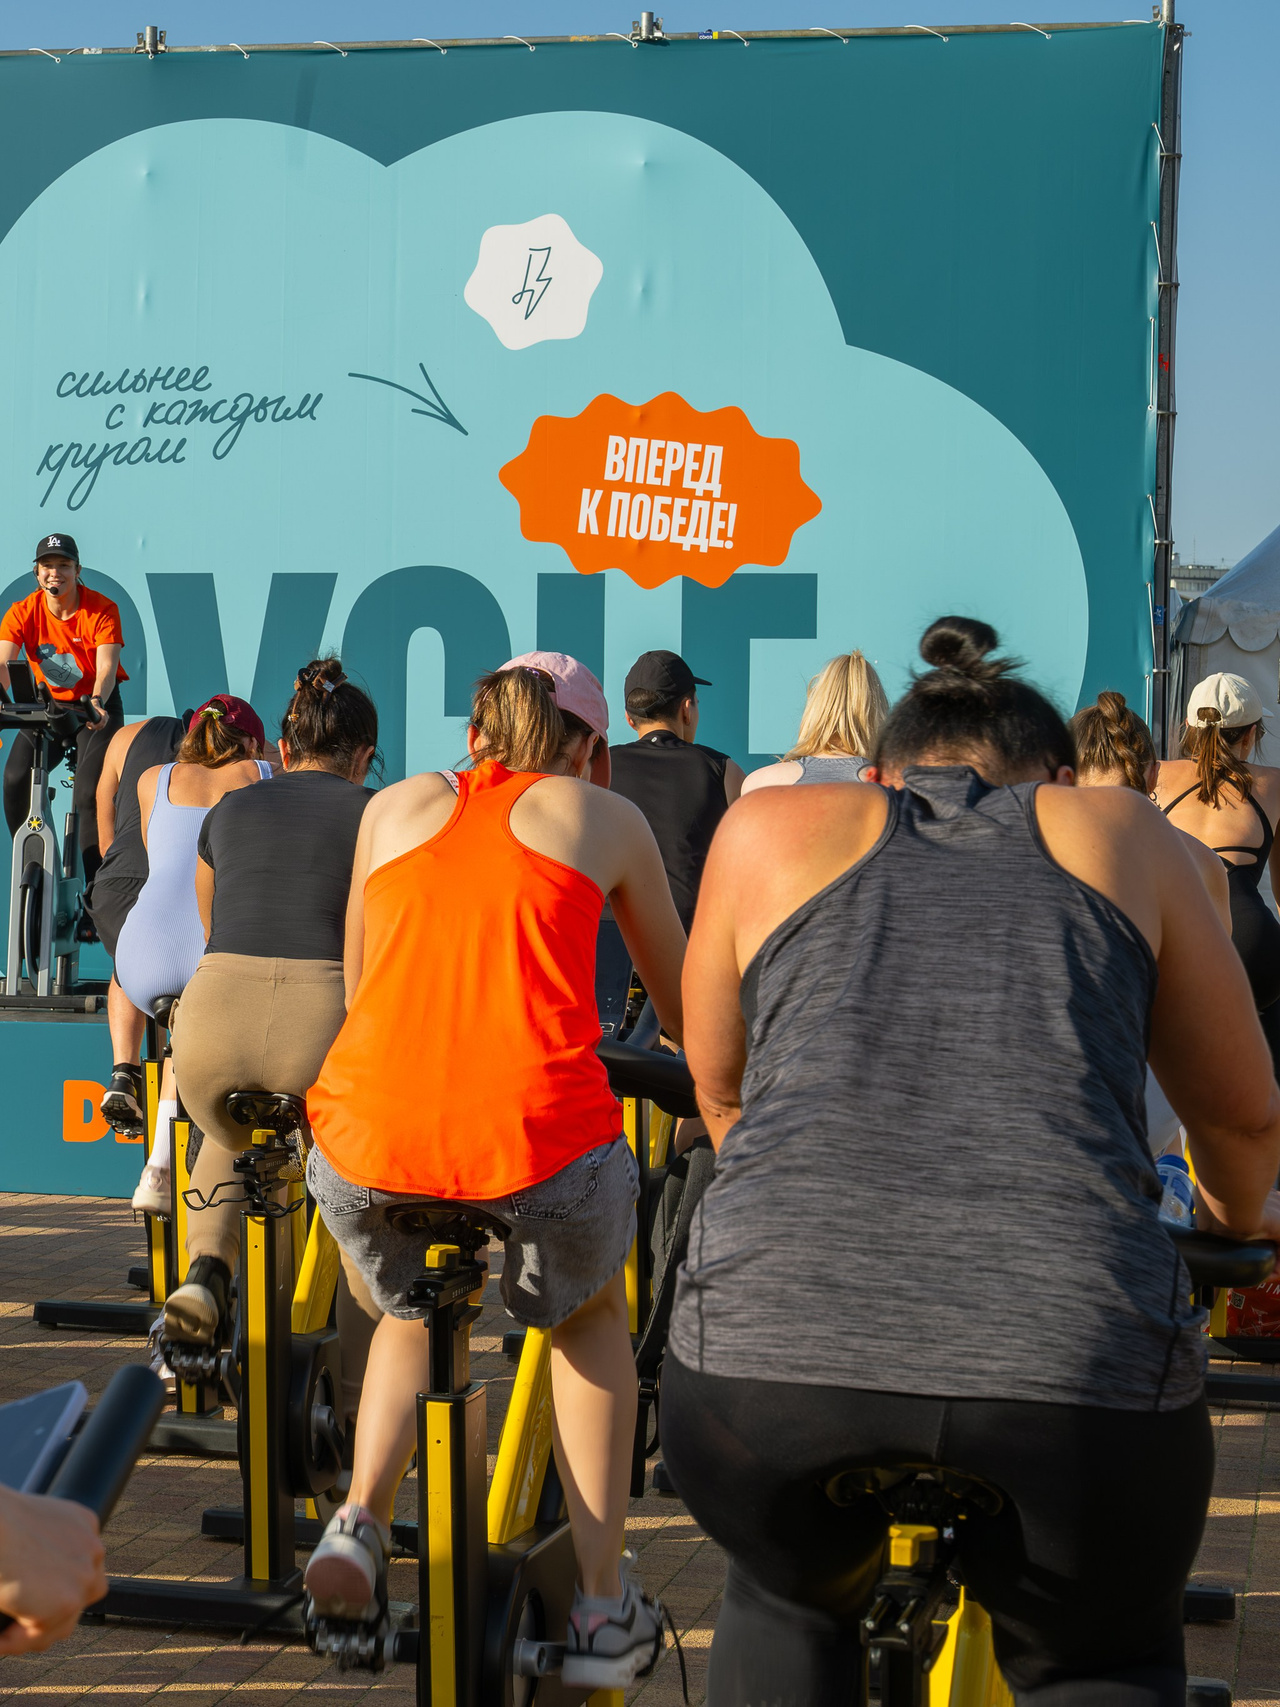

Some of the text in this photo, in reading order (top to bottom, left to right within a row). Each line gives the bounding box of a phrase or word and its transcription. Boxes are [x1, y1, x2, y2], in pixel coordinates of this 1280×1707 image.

[56, 365, 212, 398] сильнее
[105, 392, 324, 461] с каждым
[35, 436, 187, 512] кругом
[603, 434, 724, 498] ВПЕРЕД
[47, 535, 61, 548] LA
[577, 488, 738, 553] К ПОБЕДЕ!
